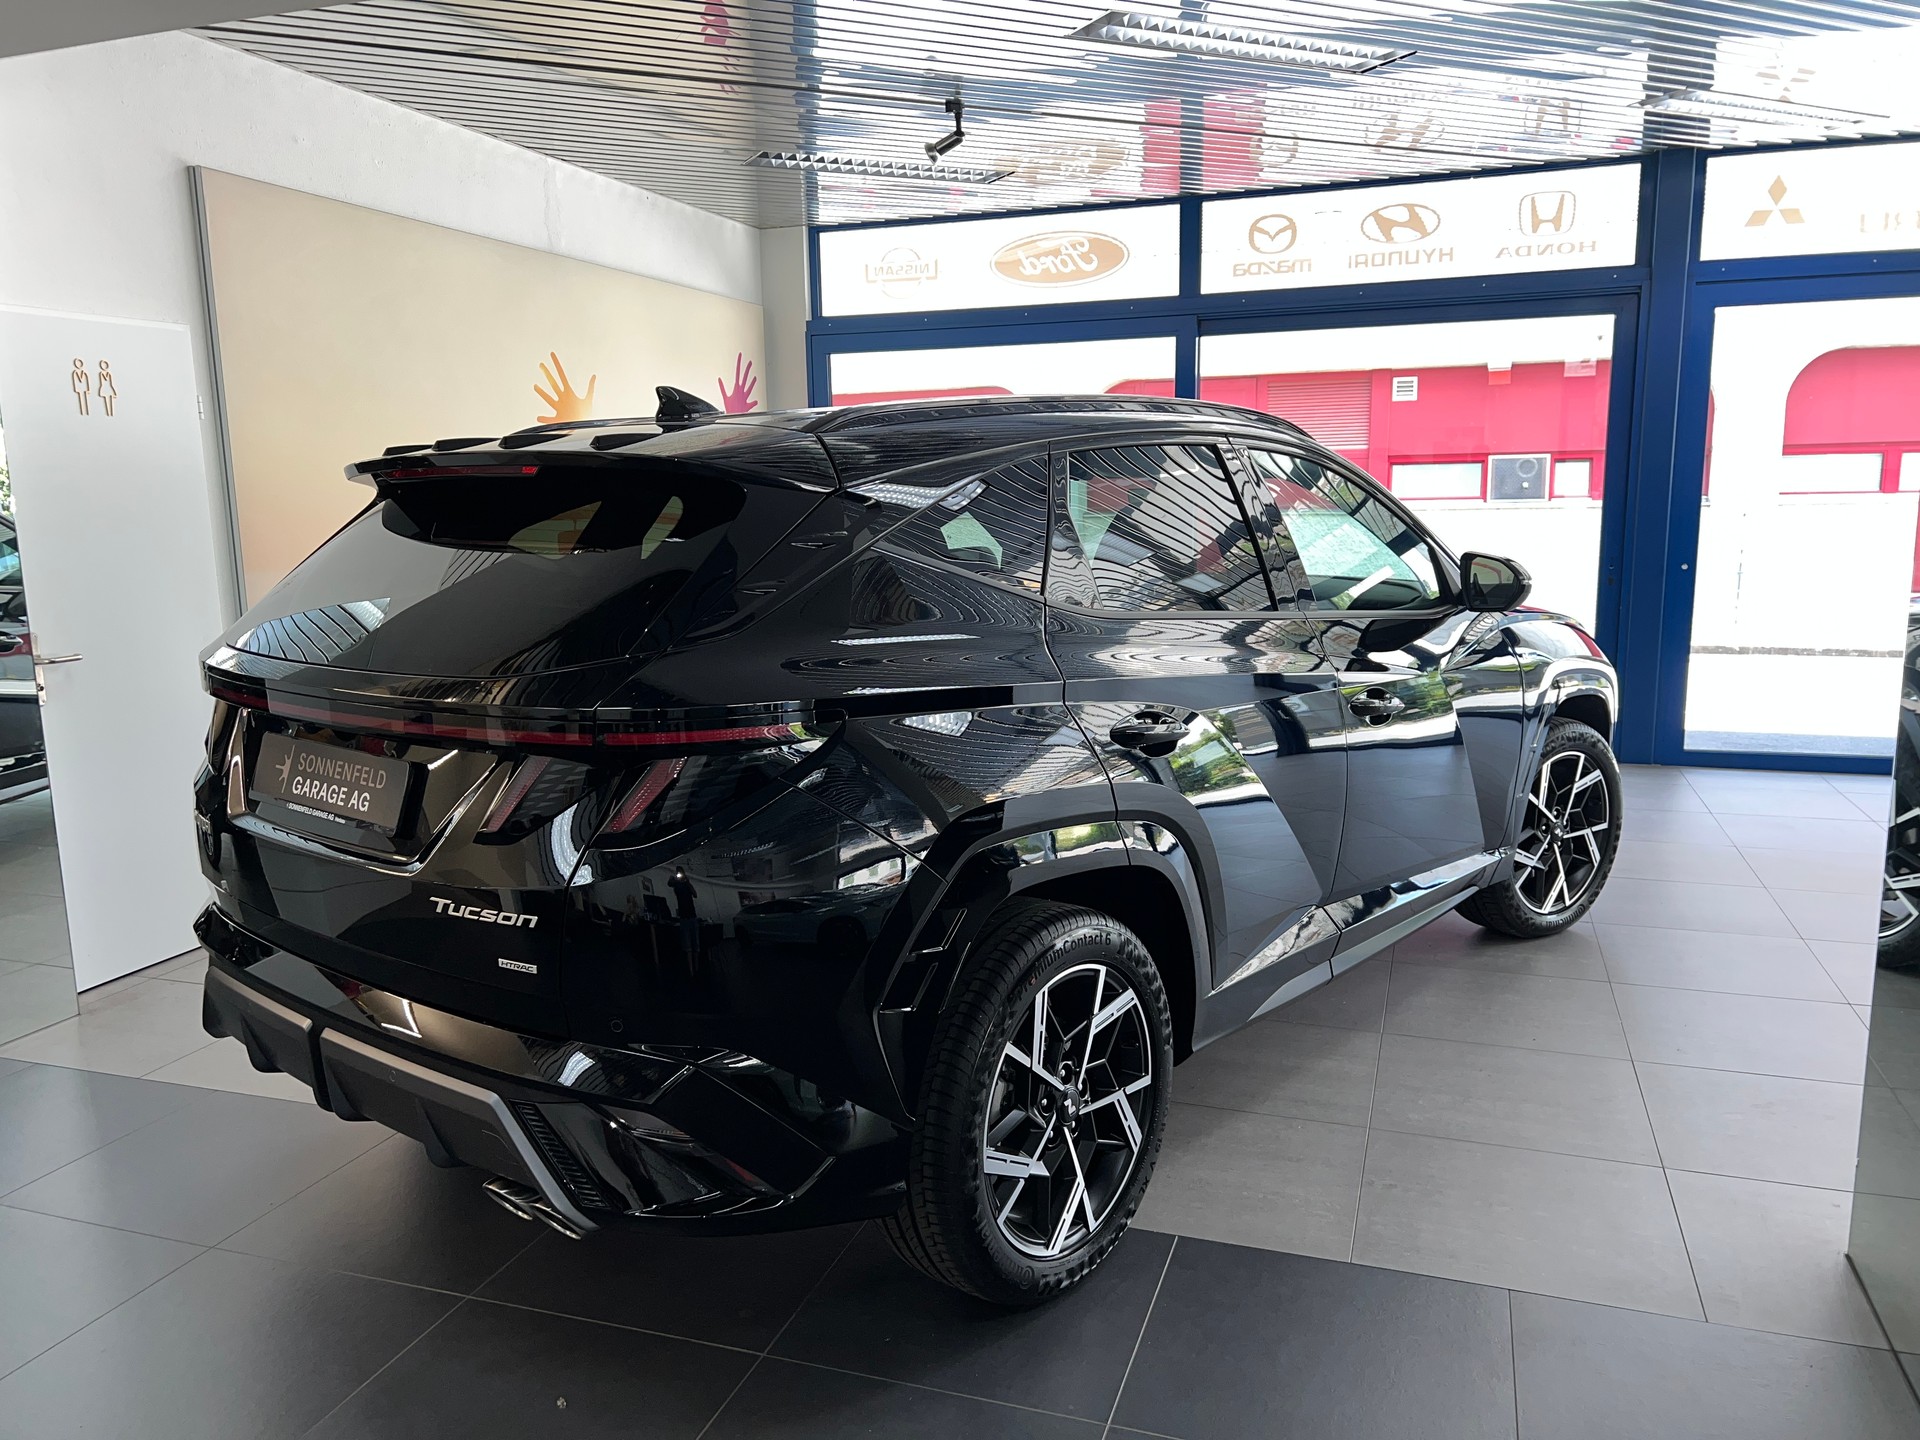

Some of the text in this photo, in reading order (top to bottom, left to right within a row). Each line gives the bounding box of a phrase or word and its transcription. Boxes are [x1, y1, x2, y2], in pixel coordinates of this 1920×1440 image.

[298, 753, 387, 789] SONNENFELD
[292, 776, 370, 812] GARAGE AG
[1105, 934, 1111, 946] 6
[500, 960, 534, 973] HTRAC
